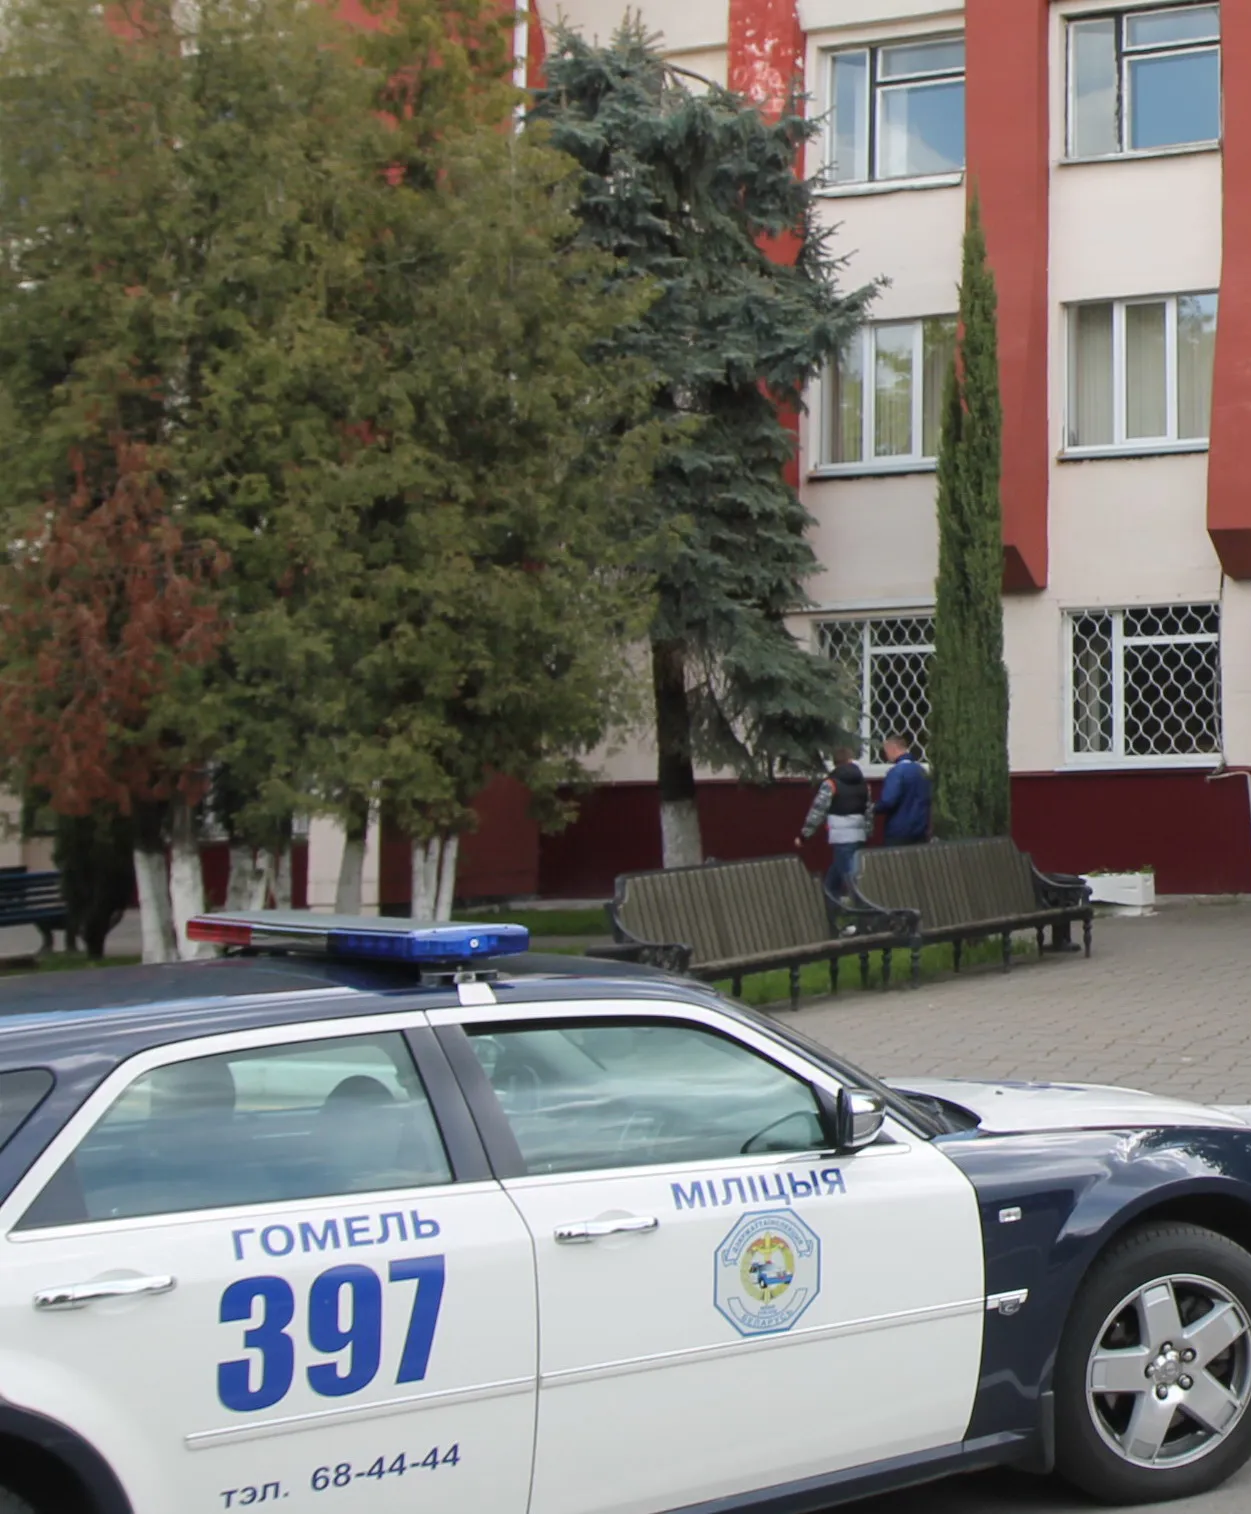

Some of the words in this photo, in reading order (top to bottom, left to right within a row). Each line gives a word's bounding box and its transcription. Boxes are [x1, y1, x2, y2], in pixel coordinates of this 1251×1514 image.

[670, 1168, 847, 1210] МІЛІЦЫЯ
[231, 1210, 441, 1261] ГОМЕЛЬ
[216, 1254, 446, 1413] 397
[219, 1480, 290, 1509] тэл.
[310, 1442, 462, 1491] 68-44-44
